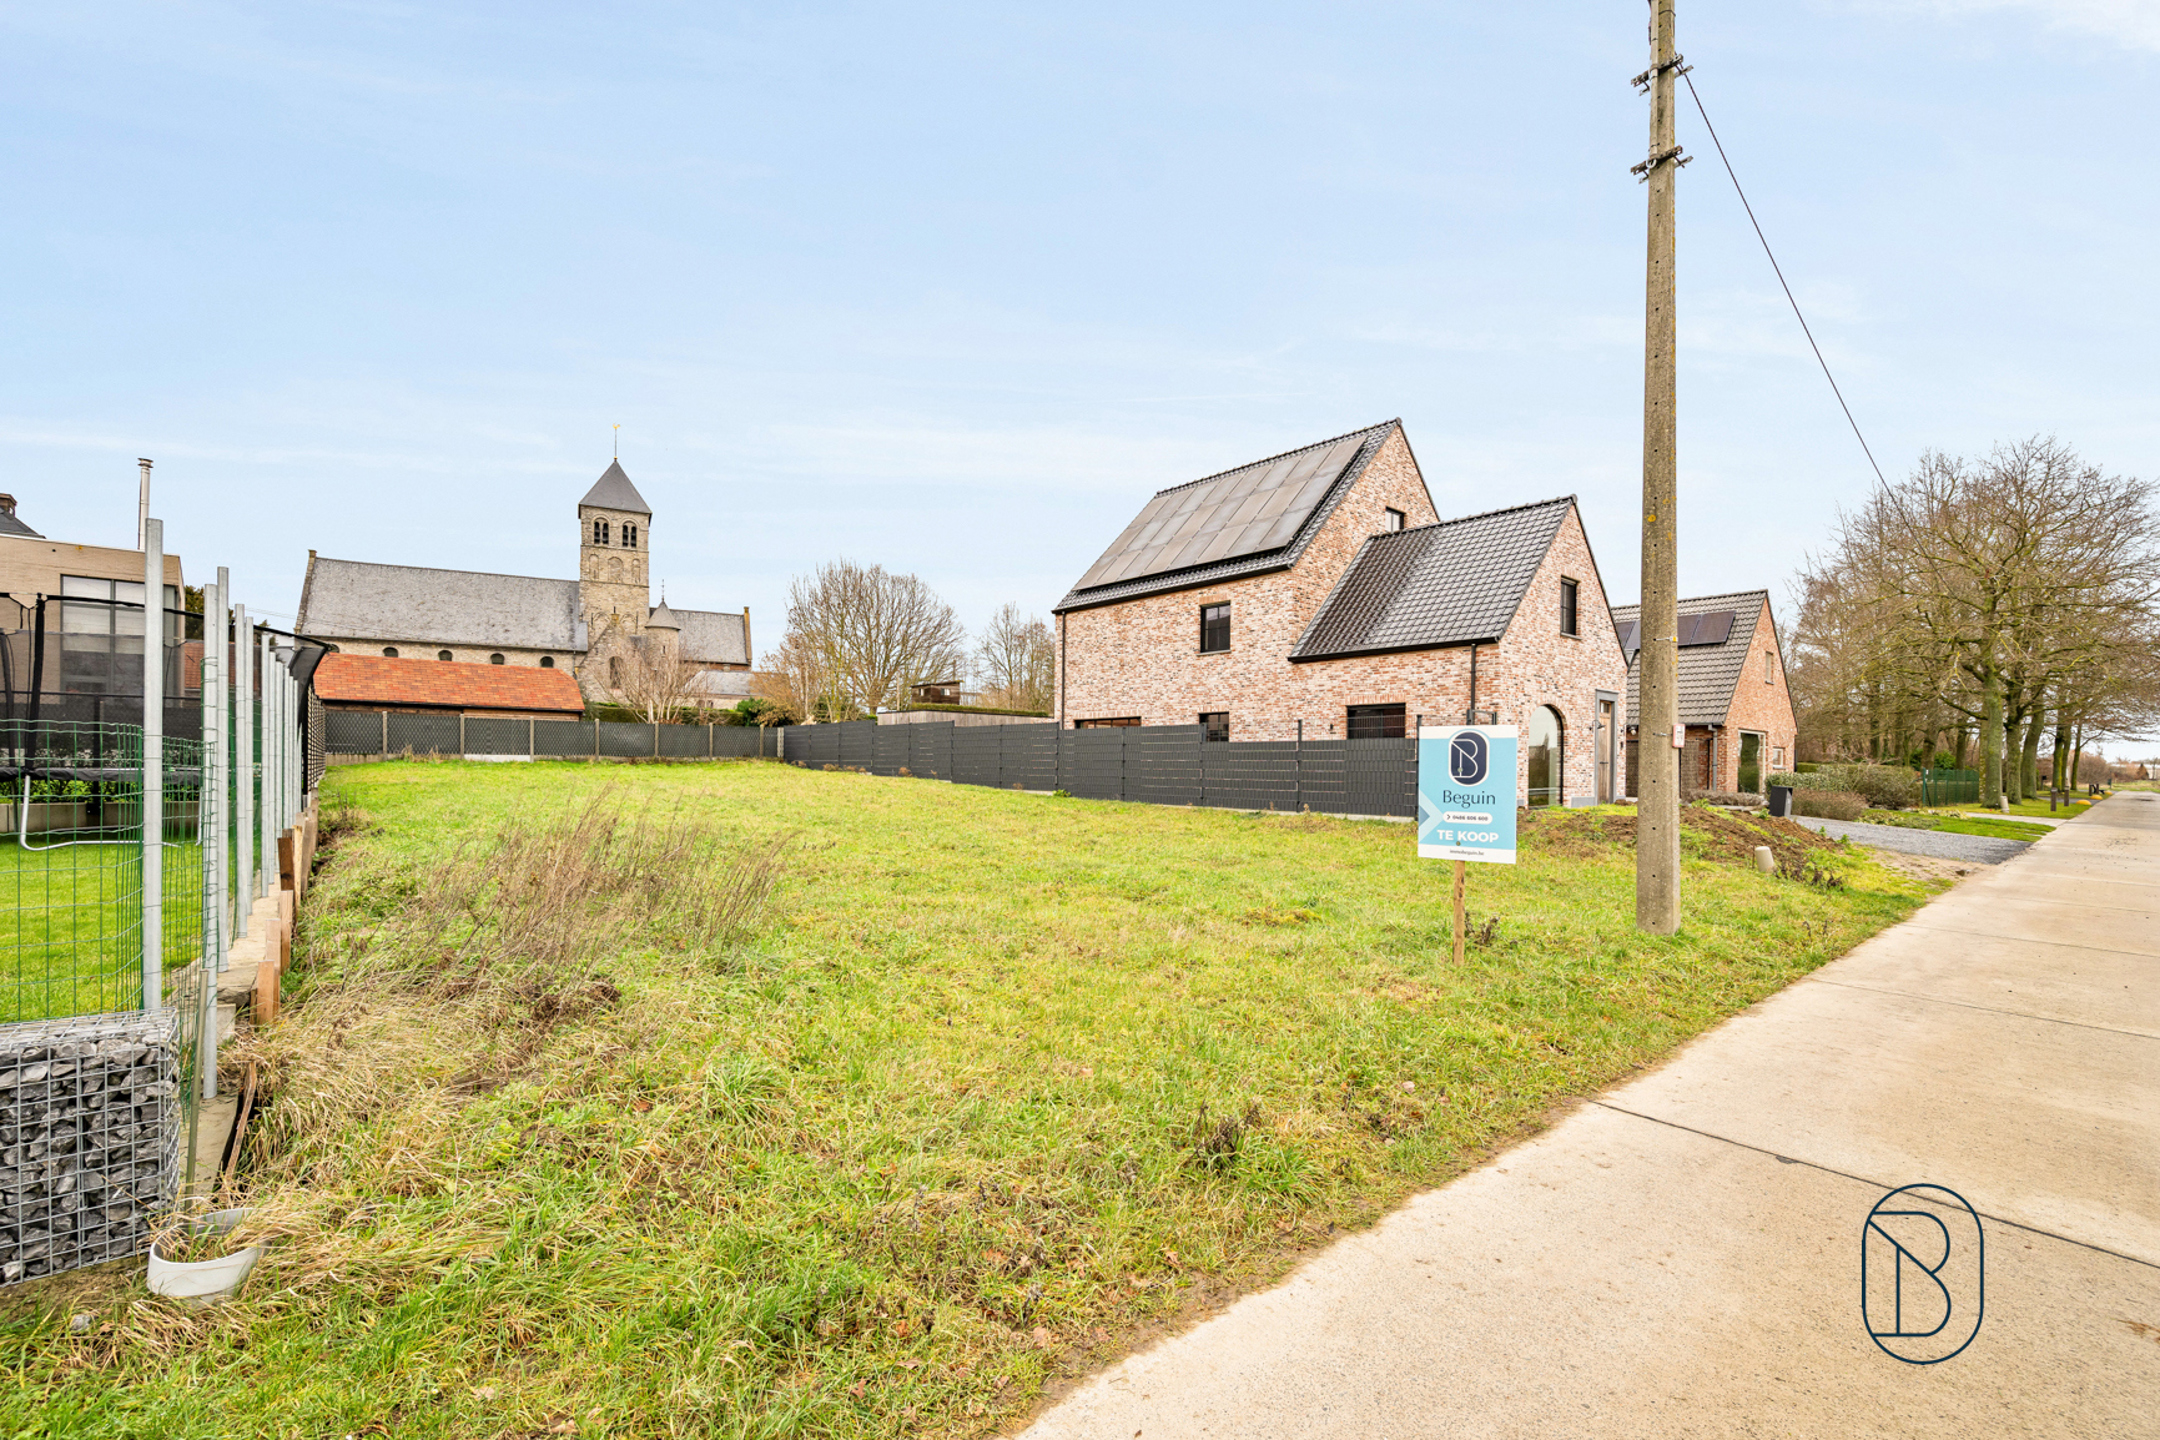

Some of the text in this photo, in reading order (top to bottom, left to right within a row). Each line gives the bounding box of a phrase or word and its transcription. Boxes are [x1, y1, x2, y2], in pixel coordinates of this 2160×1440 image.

[1443, 790, 1496, 809] Beguin
[1437, 829, 1499, 843] TE KOOP
